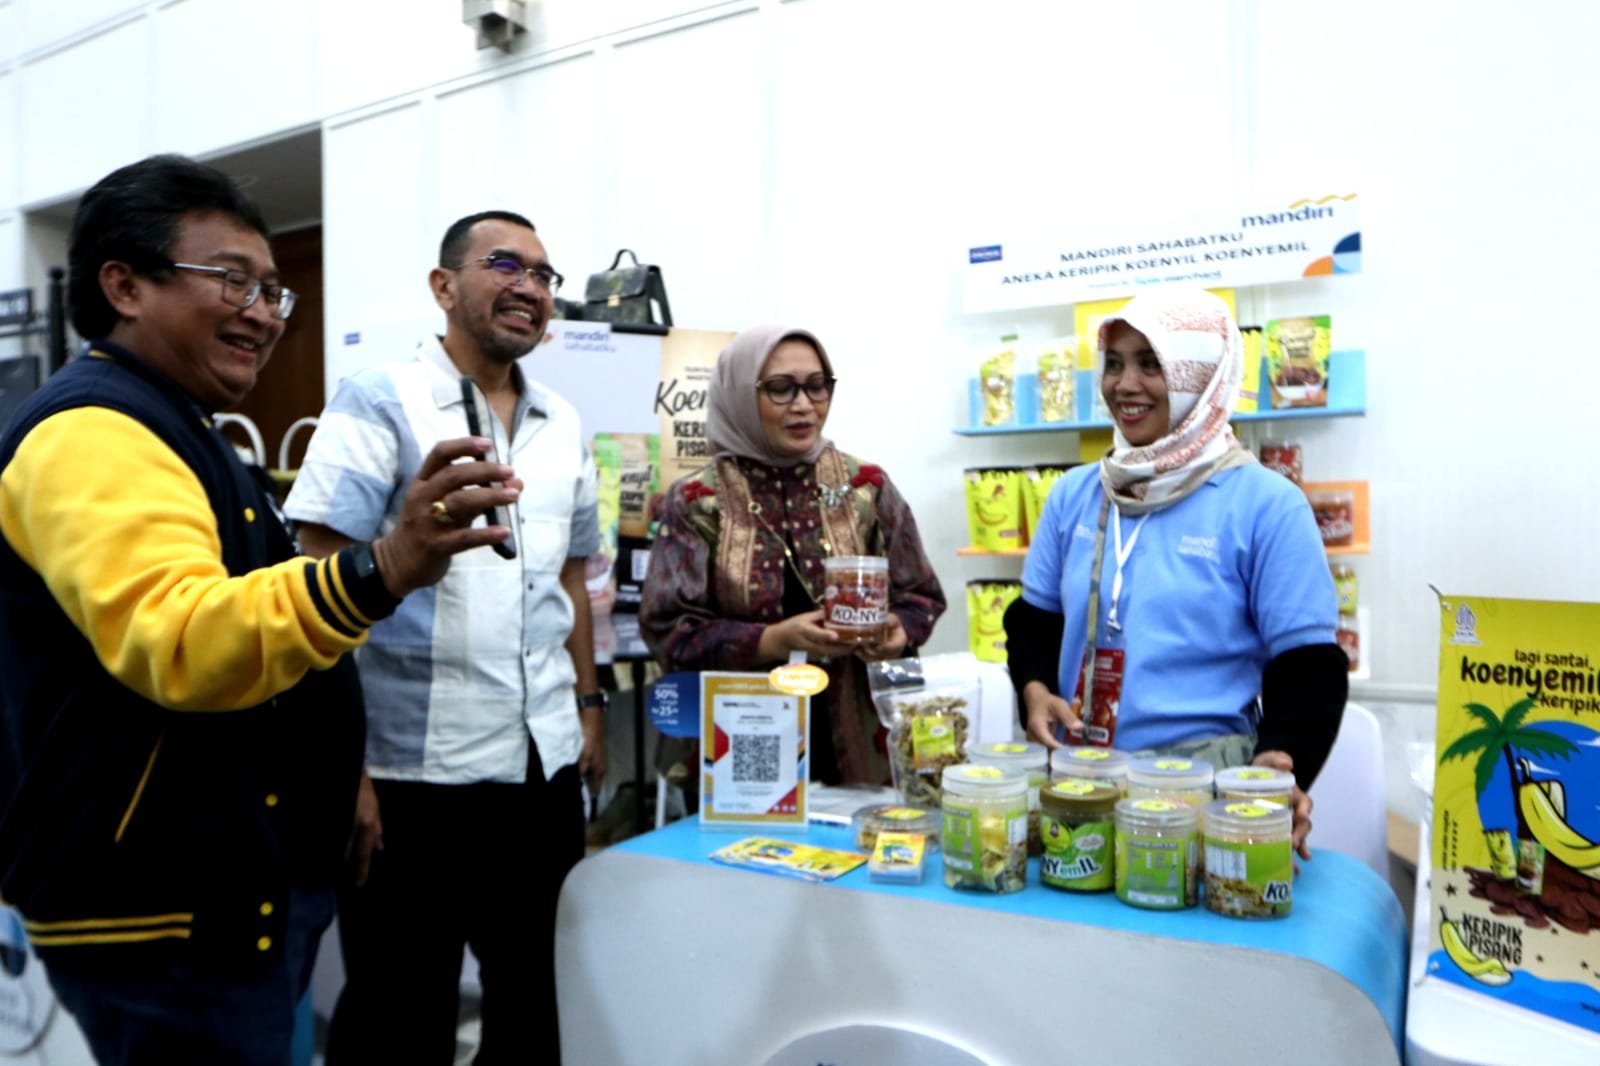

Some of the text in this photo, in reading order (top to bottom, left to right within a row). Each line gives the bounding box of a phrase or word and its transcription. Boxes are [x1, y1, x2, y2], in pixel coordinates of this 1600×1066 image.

[1241, 204, 1333, 228] mandiri
[1060, 232, 1244, 262] MANDIRI SAHABATKU
[1002, 241, 1310, 285] ANEKA KERIPIK KOENYIL KOENYEMIL
[1515, 649, 1588, 668] lagi santai
[1541, 694, 1600, 716] keripik
[1463, 912, 1522, 946] KERIPIK
[1470, 934, 1522, 966] PISANG
